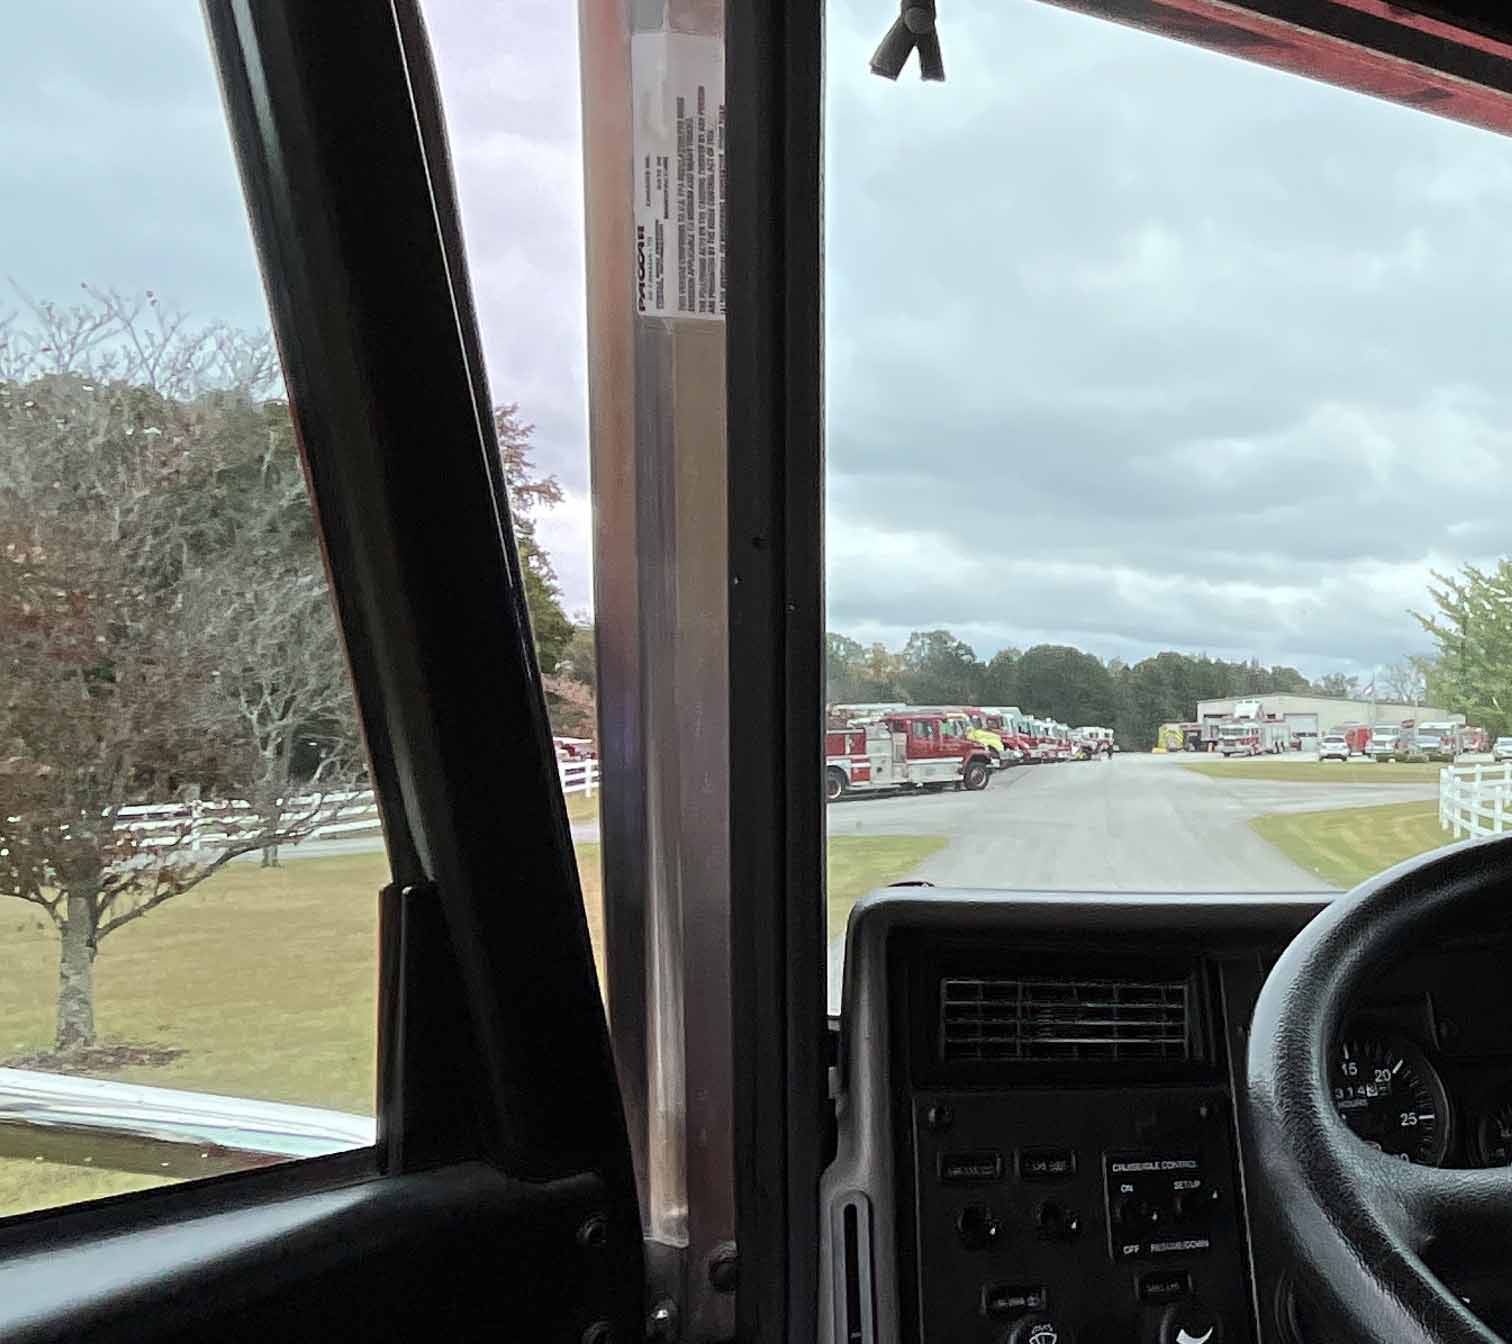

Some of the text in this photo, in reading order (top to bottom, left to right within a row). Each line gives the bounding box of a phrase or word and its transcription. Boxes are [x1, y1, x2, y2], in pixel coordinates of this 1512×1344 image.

[1341, 1062, 1358, 1076] 15
[1374, 1068, 1392, 1083] 20
[1400, 1112, 1418, 1126] 25
[1123, 1244, 1140, 1255] OFF
